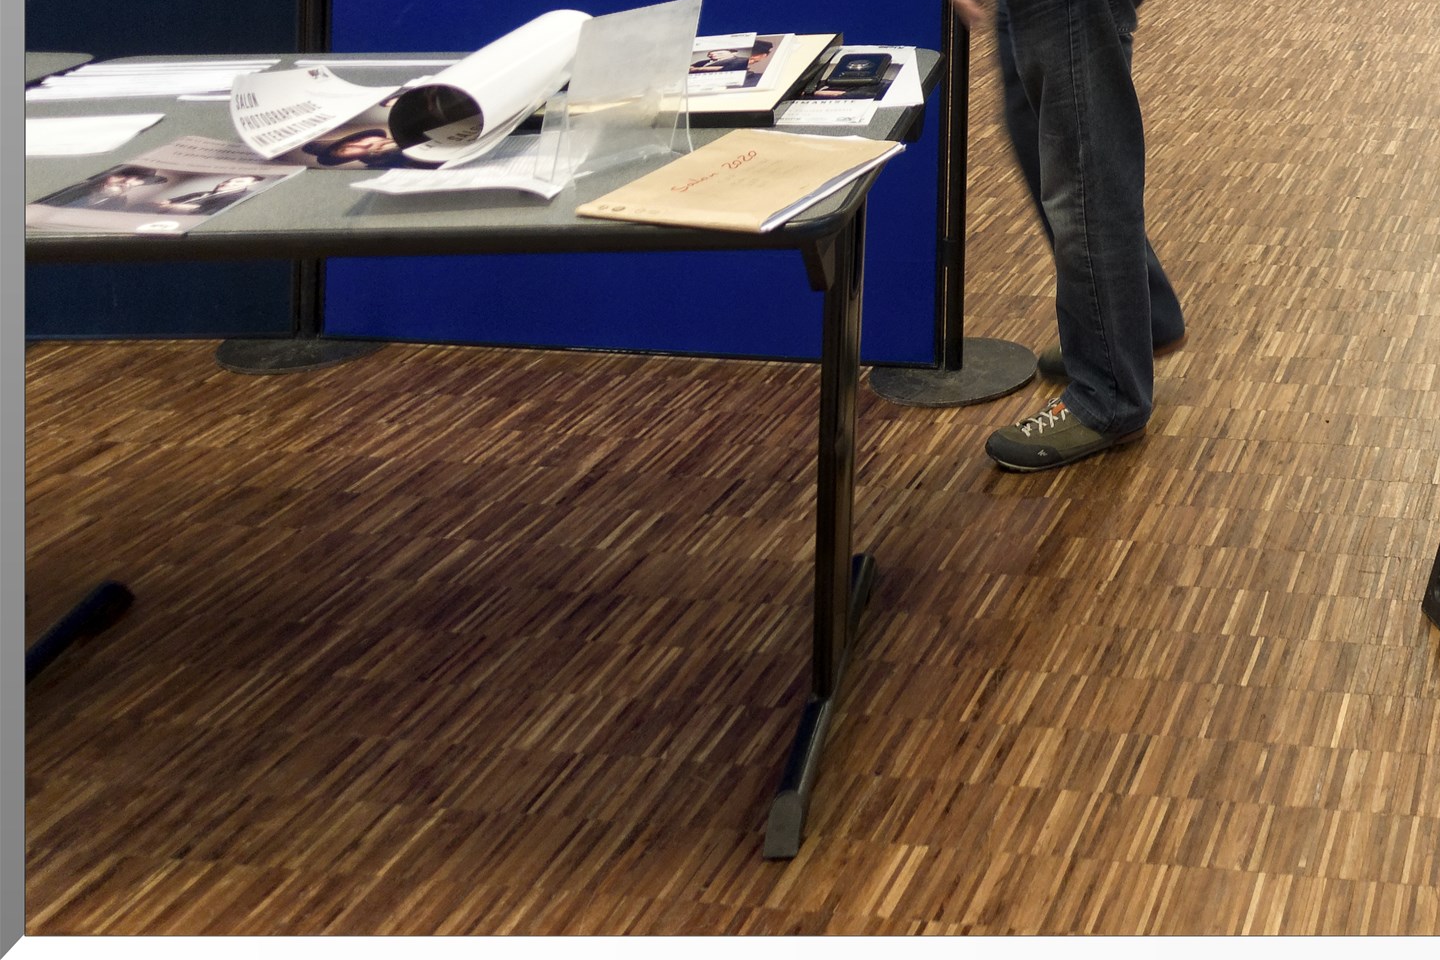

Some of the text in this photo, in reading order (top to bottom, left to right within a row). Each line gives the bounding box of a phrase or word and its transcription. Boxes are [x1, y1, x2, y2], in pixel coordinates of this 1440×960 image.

[234, 92, 260, 111] SALON
[239, 99, 323, 131] PHOTOGRAPHIQUE
[251, 113, 337, 148] INTERNATIONAL
[721, 150, 757, 169] 2020
